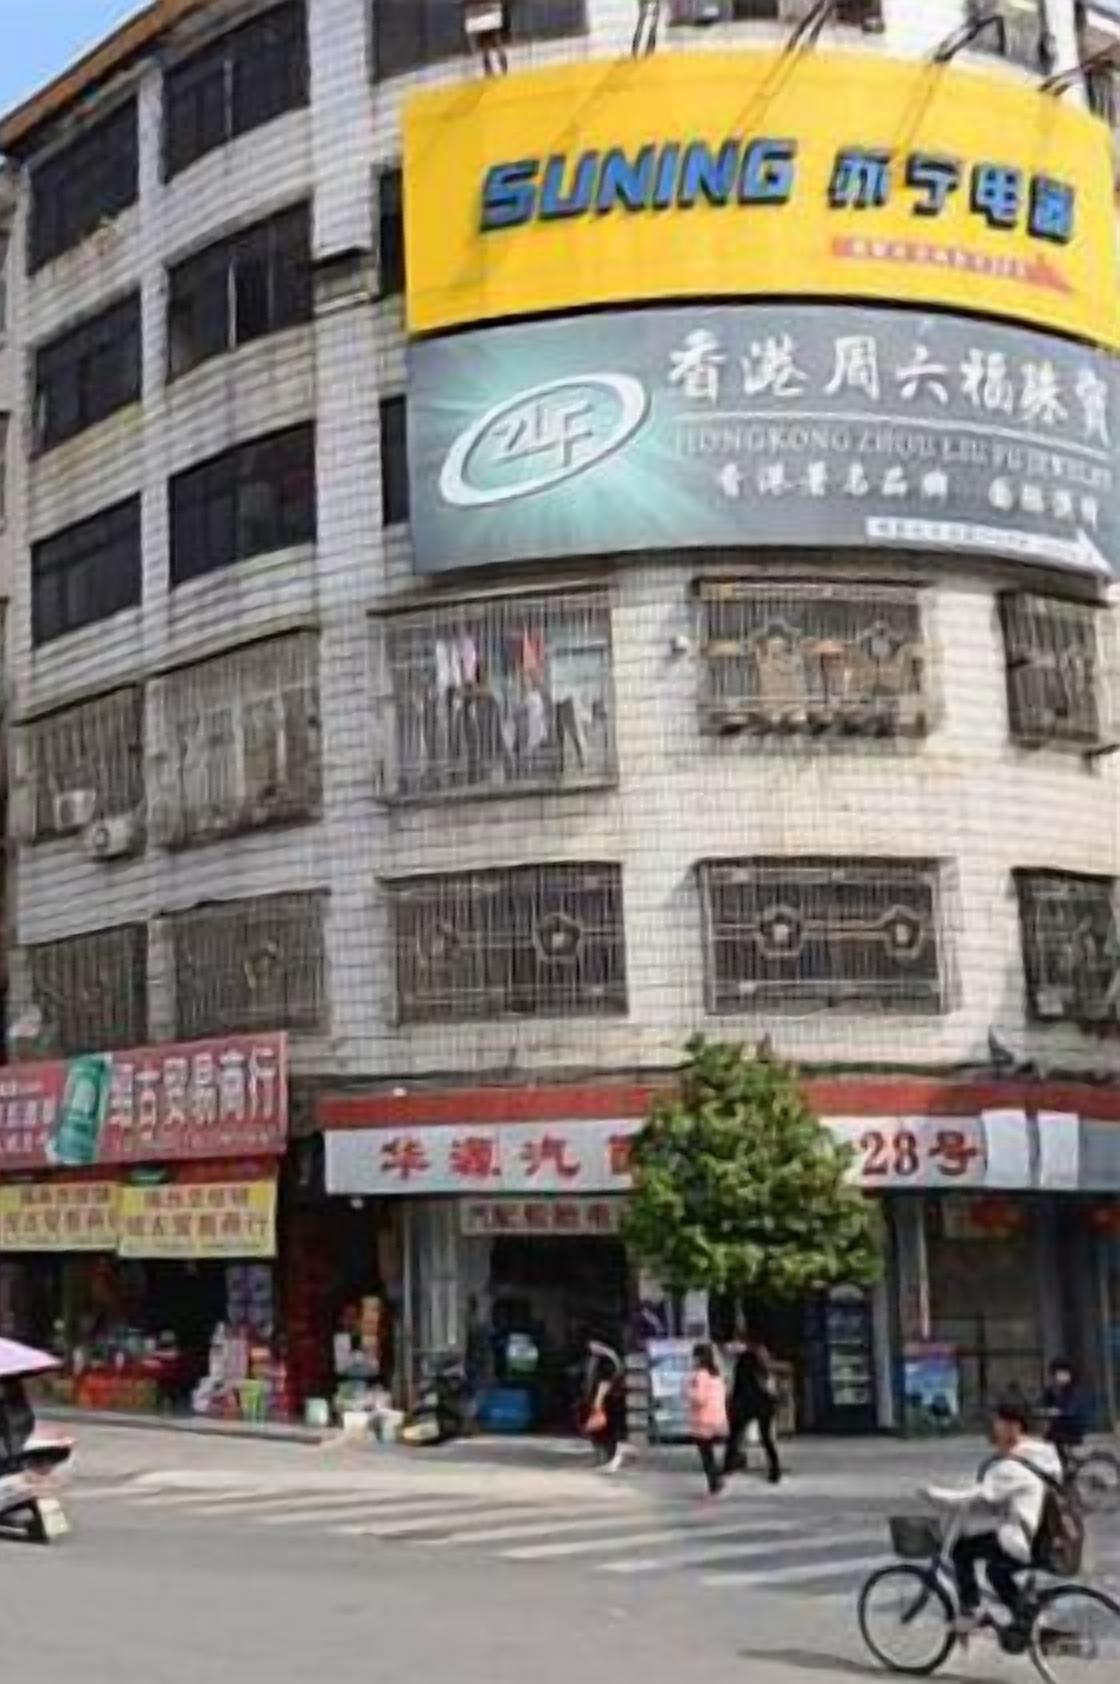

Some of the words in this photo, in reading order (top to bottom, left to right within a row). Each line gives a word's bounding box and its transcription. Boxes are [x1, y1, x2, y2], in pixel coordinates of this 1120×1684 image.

[482, 138, 796, 231] SUNING
[828, 145, 1076, 245] 苏宁电器
